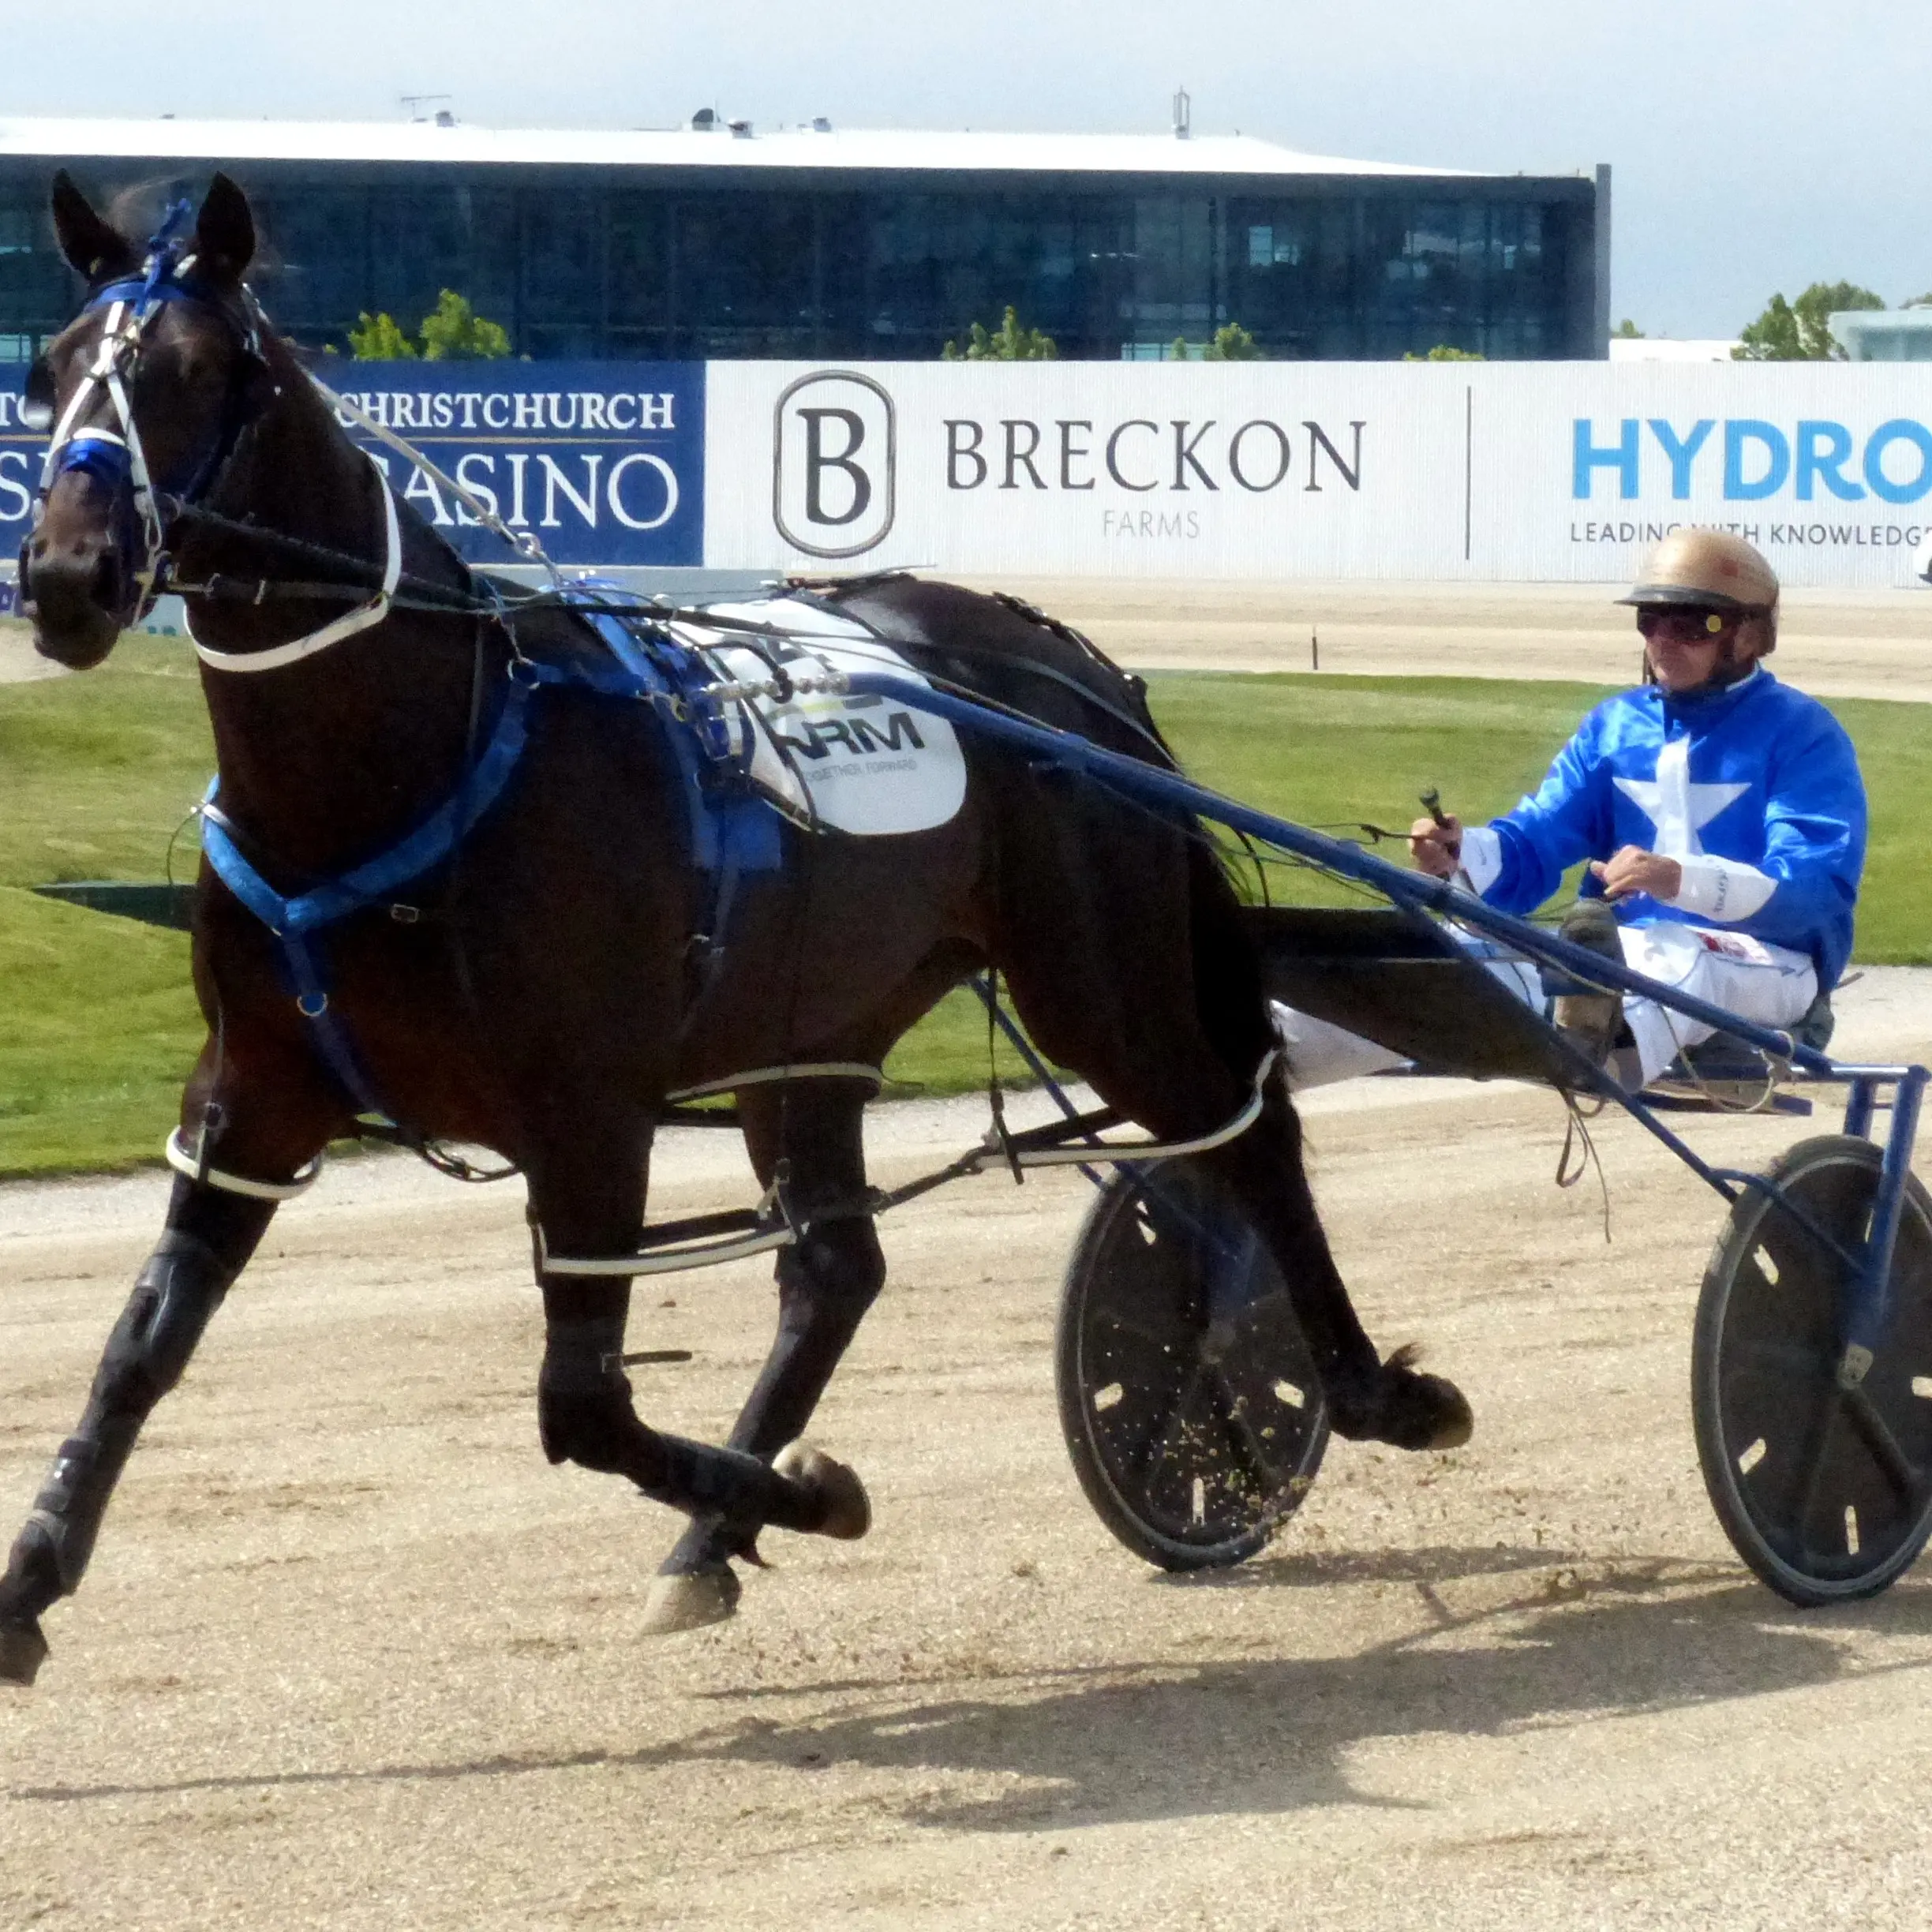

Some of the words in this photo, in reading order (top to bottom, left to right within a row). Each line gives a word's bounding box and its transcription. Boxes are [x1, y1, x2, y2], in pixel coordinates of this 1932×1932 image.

[333, 391, 676, 429] CHRISTCHURCH
[796, 408, 872, 526] B
[942, 419, 1367, 492] BRECKON
[1572, 418, 1932, 505] HYDRO
[1103, 510, 1200, 539] FARMS
